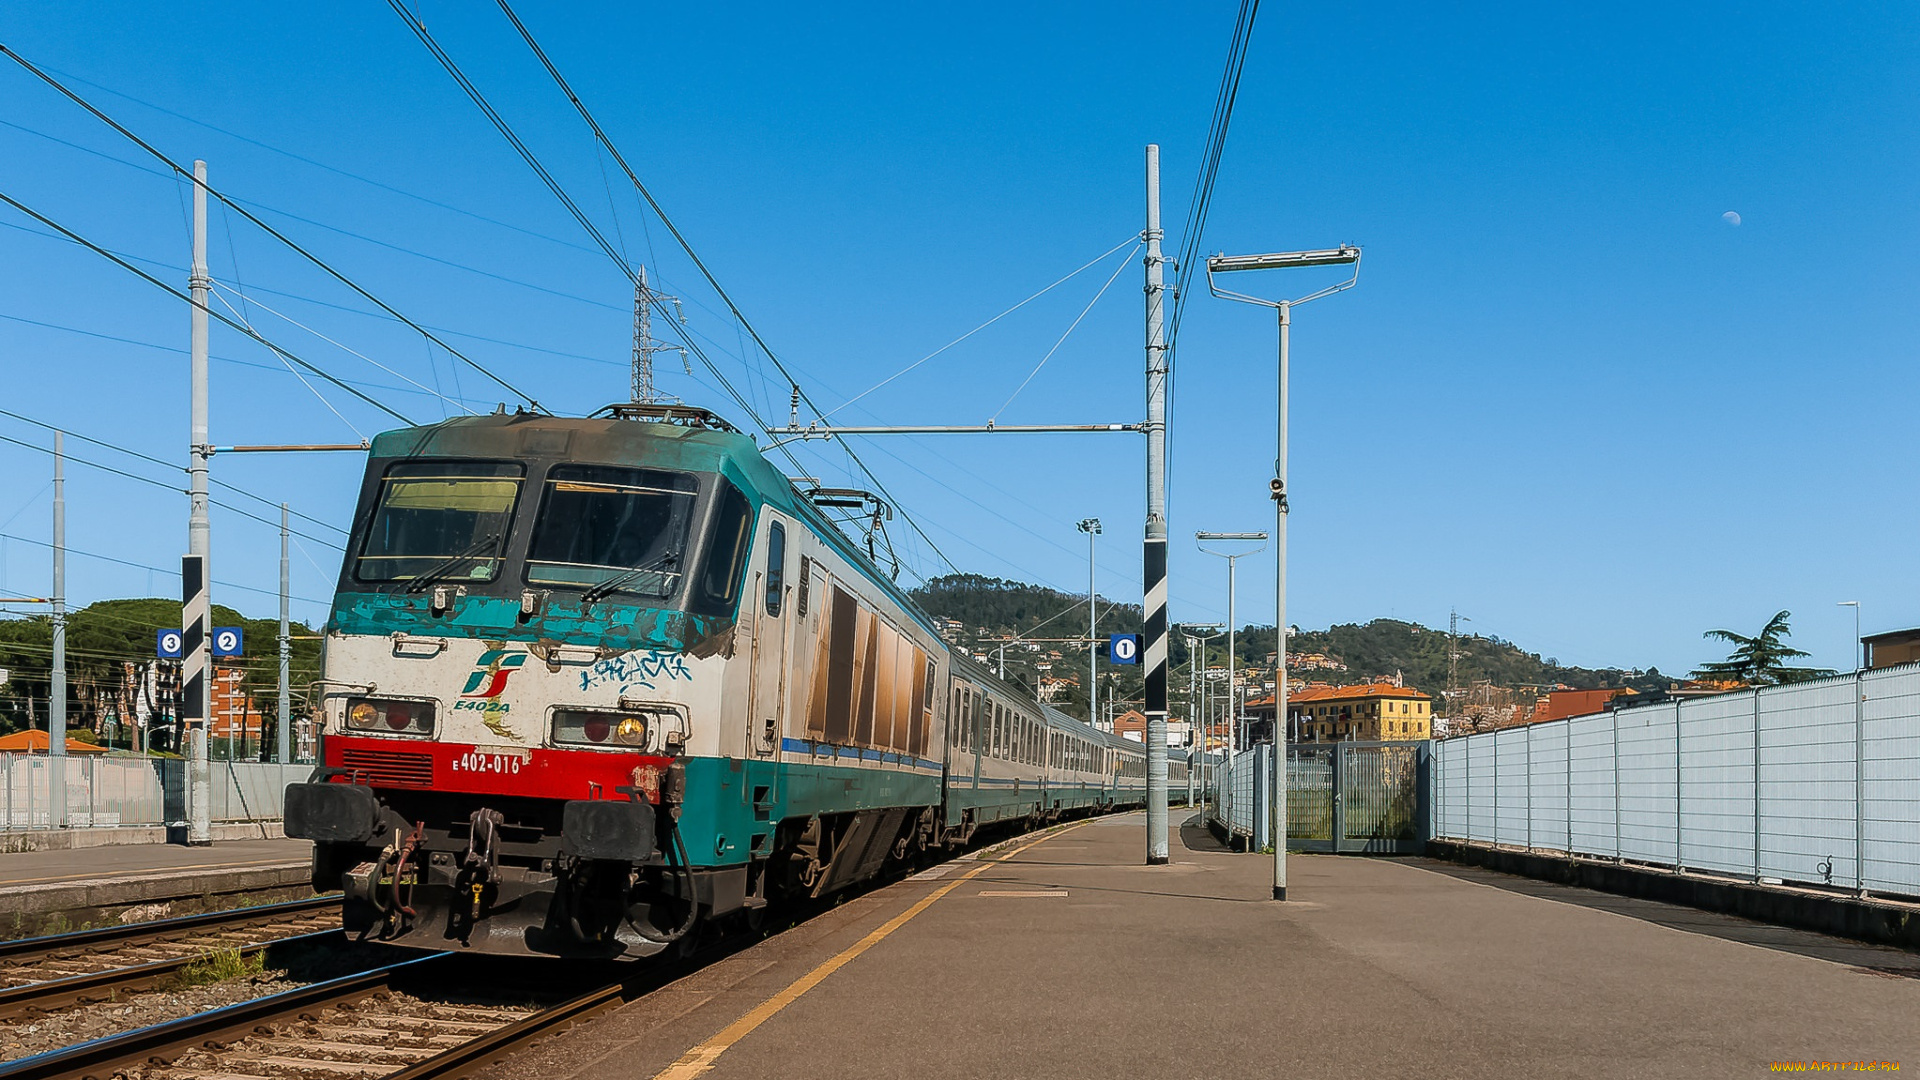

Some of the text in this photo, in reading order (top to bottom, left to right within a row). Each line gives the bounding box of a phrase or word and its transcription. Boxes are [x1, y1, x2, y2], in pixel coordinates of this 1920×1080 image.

[167, 637, 176, 649] 3
[223, 635, 232, 648] 2
[453, 700, 510, 713] E402A
